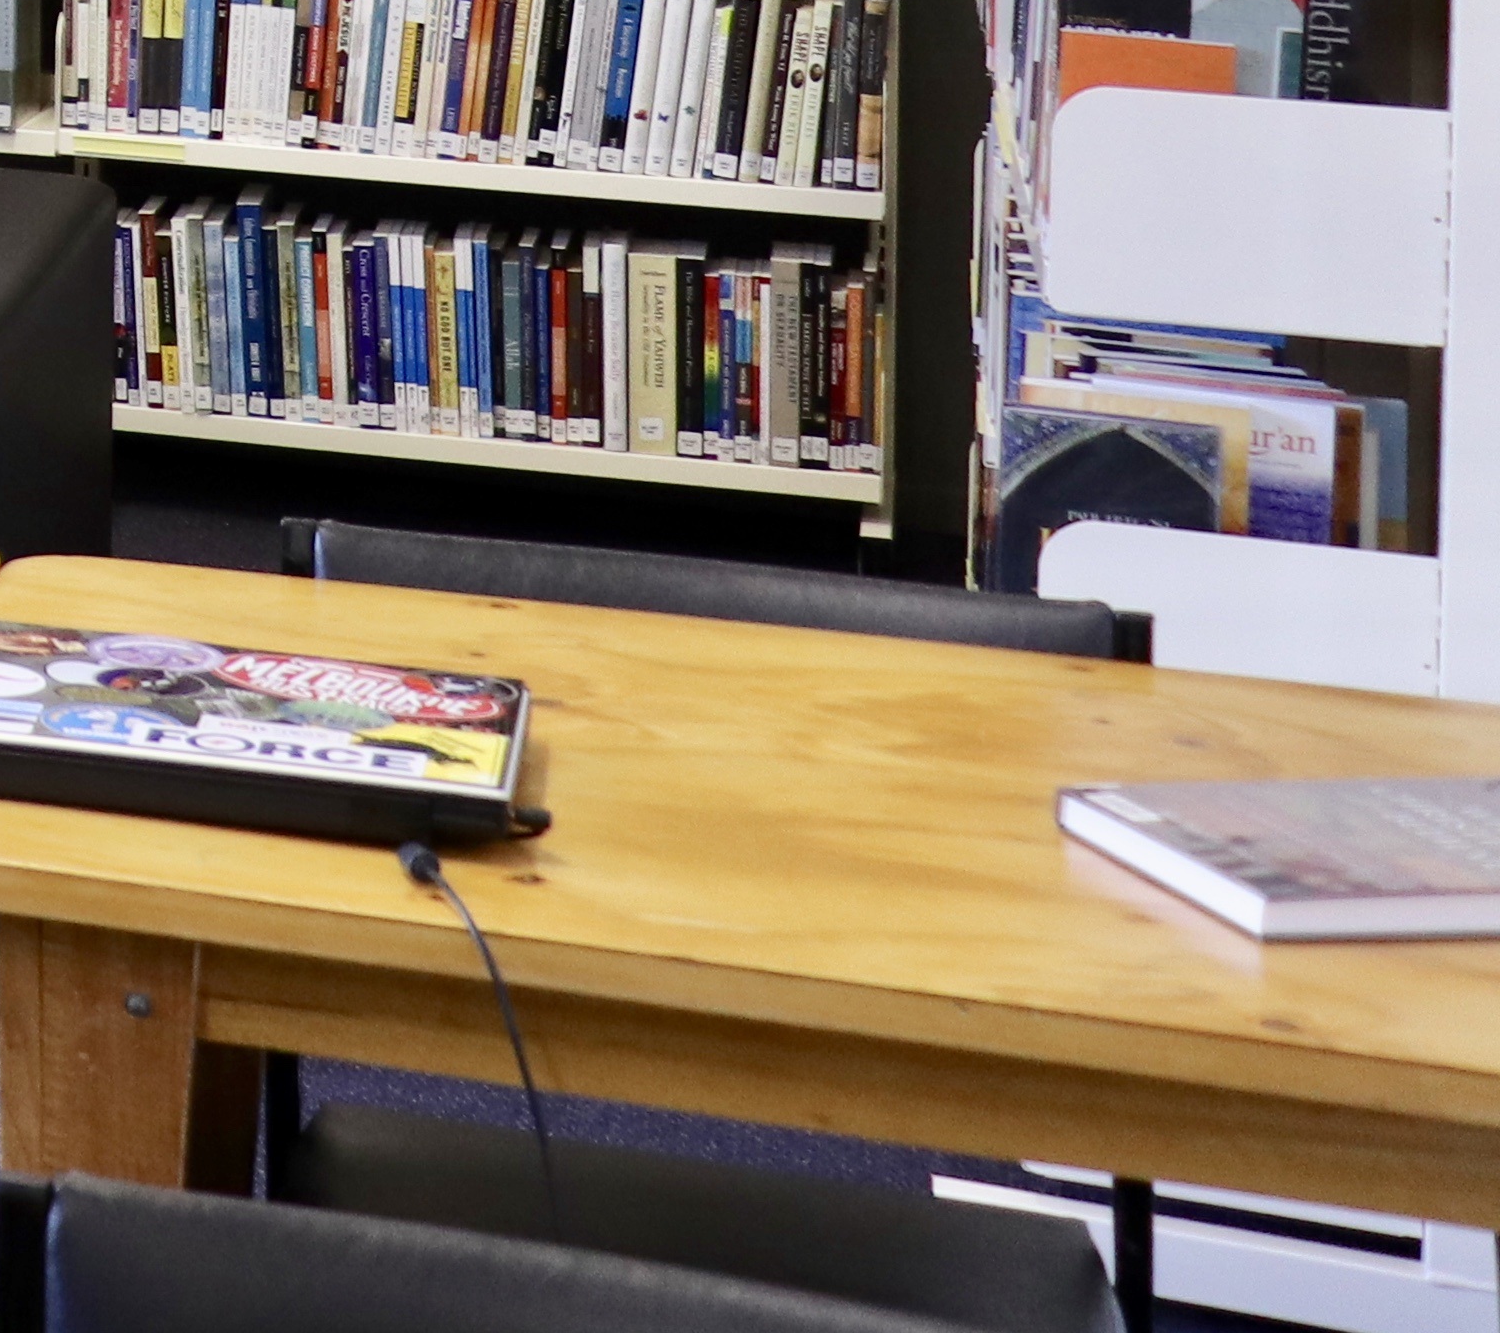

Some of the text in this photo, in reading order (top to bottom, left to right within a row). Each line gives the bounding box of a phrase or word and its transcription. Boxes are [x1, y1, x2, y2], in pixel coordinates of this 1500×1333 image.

[811, 26, 826, 58] SHAPE
[653, 285, 668, 321] FLAME
[653, 339, 667, 388] YAHWEH
[145, 727, 417, 772] FORCE
